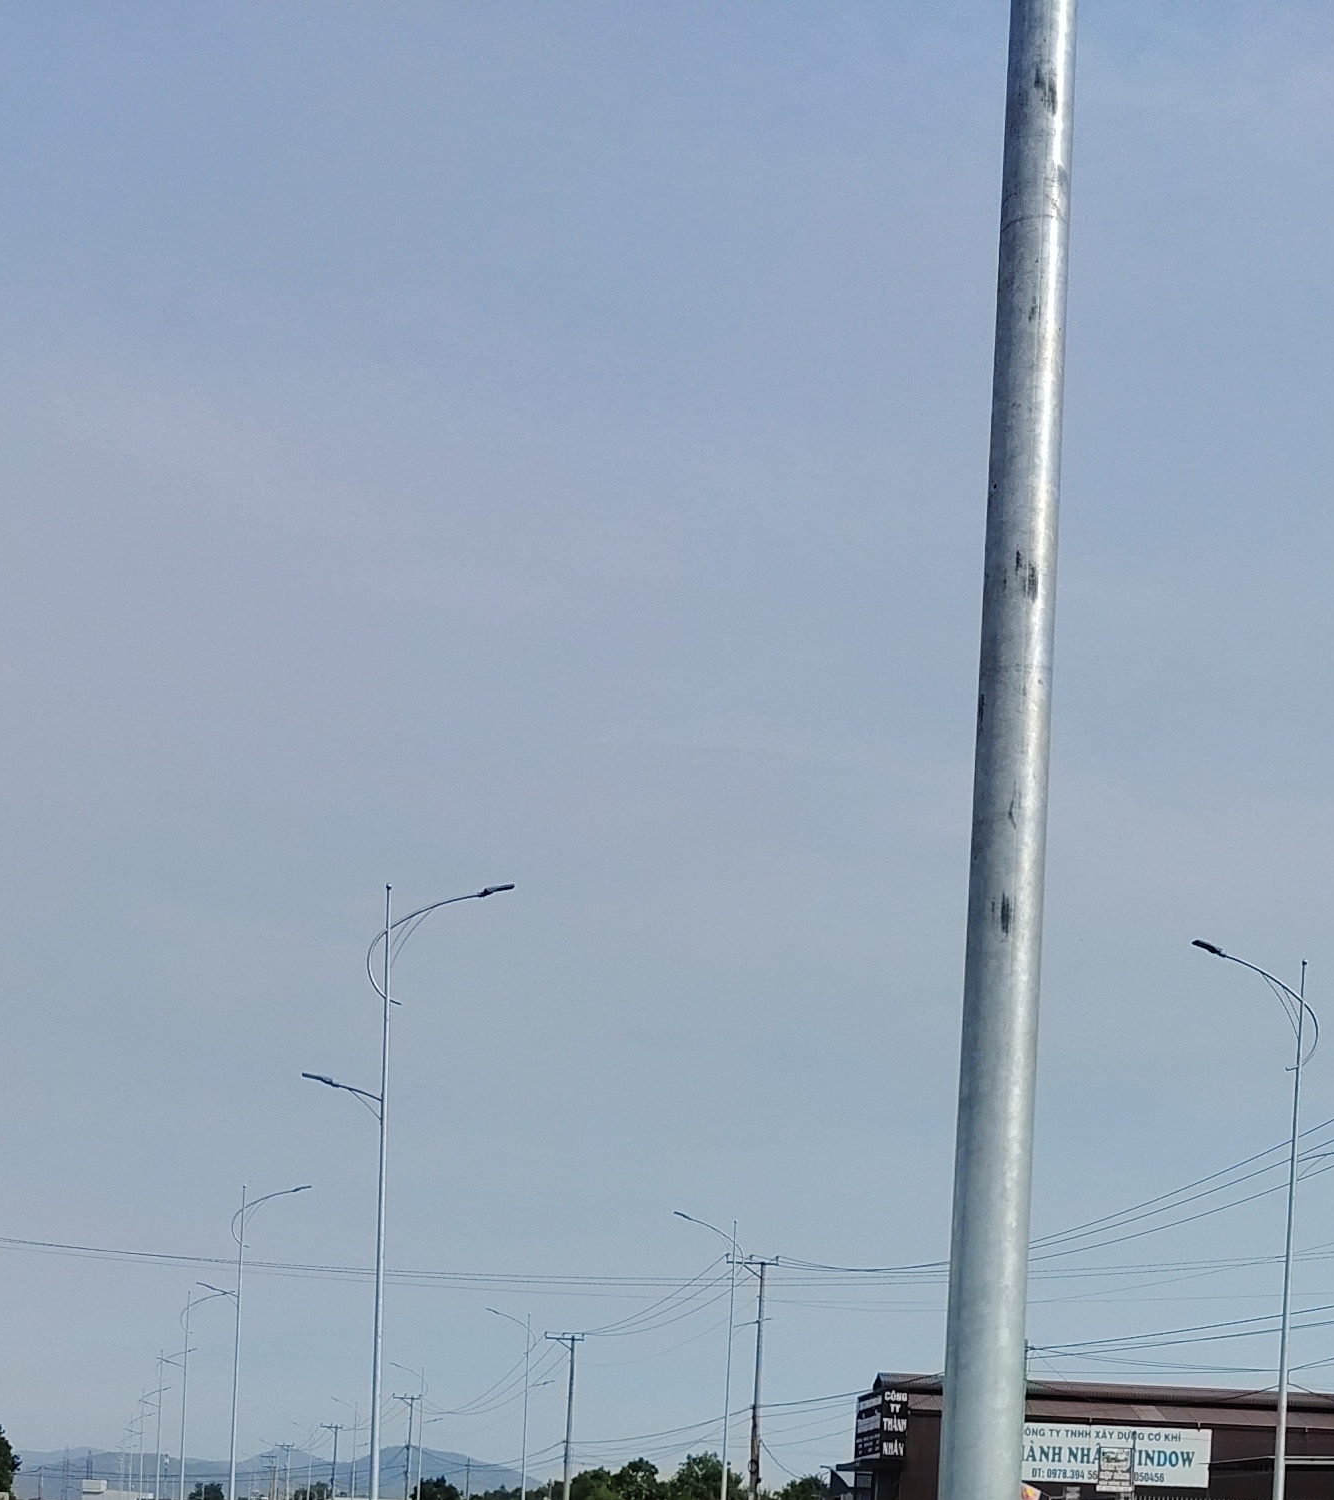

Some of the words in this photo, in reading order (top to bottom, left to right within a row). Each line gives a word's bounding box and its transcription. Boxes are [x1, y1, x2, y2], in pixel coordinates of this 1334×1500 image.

[889, 1403, 902, 1413] TY
[1024, 1427, 1046, 1437] ÔNG
[1048, 1428, 1061, 1438] TY
[1064, 1429, 1091, 1438] TNHH
[1067, 1442, 1100, 1465] NHÂ
[1137, 1449, 1195, 1469] INDOW
